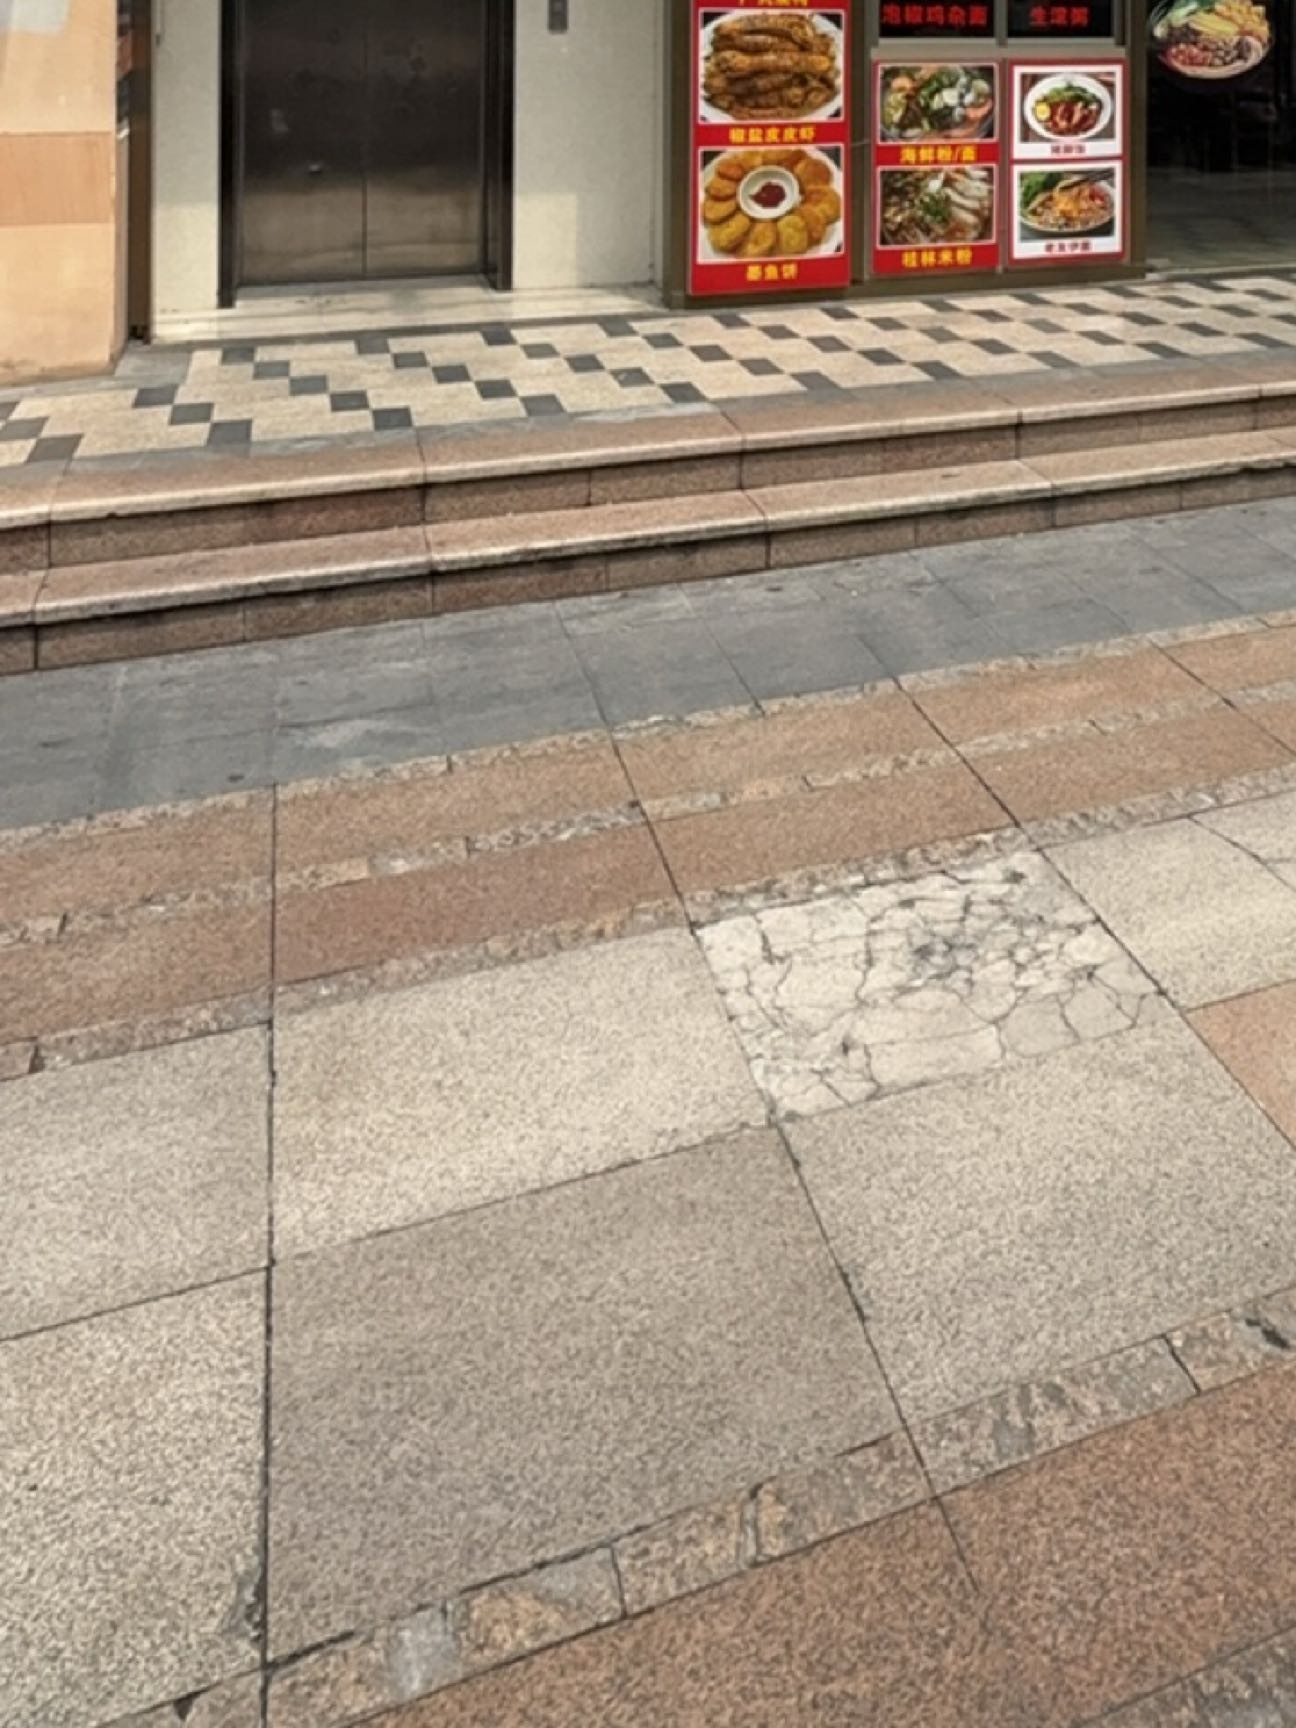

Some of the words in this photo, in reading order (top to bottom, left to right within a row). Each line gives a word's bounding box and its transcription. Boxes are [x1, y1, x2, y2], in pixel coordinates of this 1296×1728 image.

[728, 127, 816, 145] 椒盐皮皮虾
[901, 249, 973, 268] 桂林米粉
